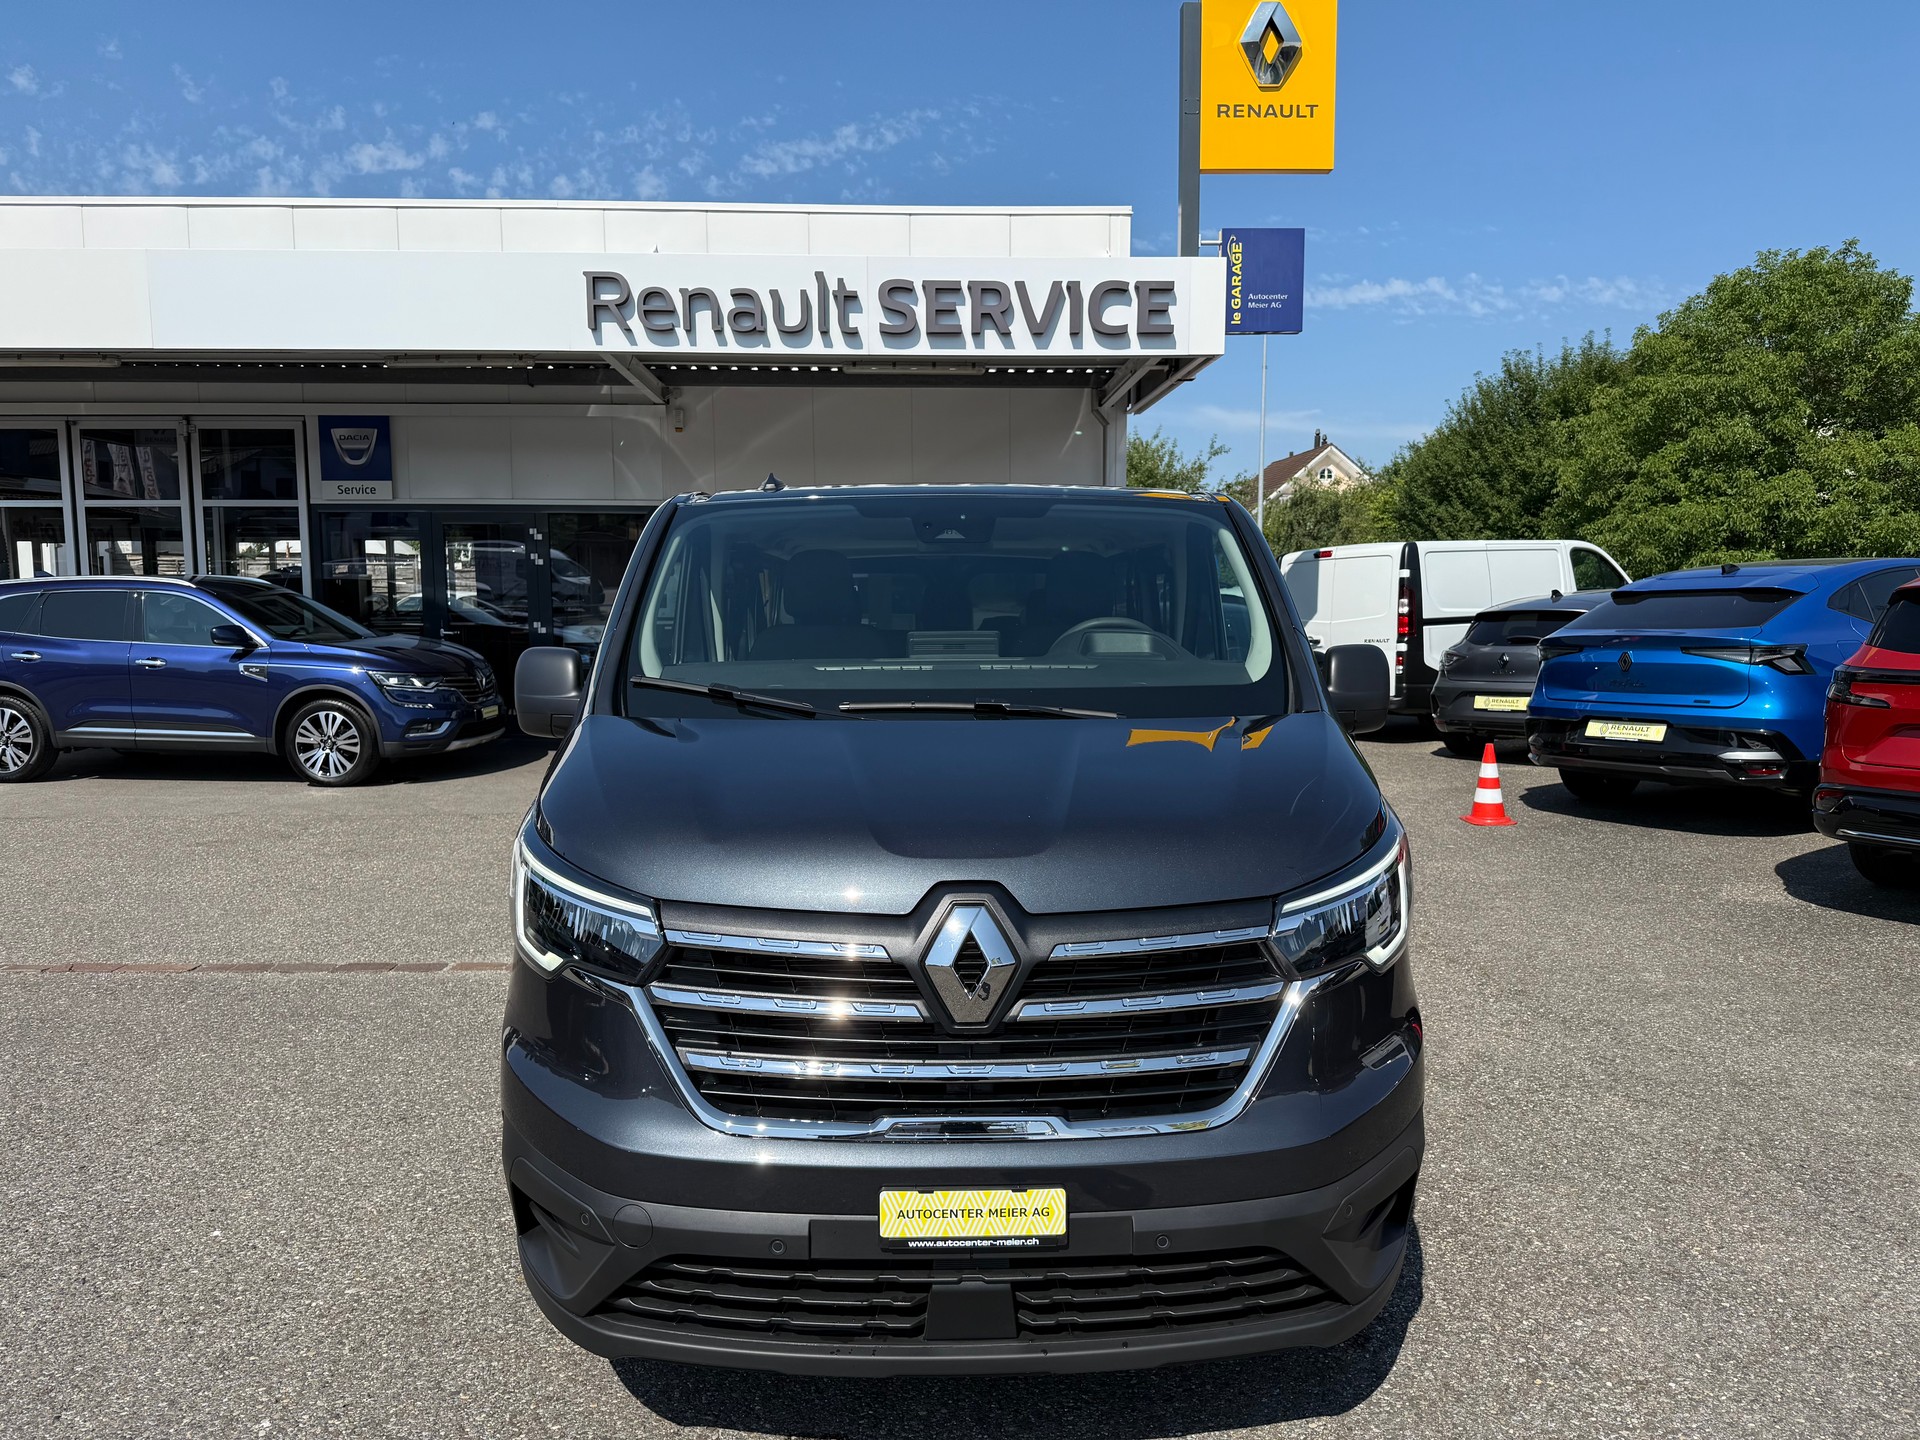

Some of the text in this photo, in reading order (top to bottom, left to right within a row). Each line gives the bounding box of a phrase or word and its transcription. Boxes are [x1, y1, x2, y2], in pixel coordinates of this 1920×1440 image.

[1217, 104, 1319, 118] RENAULT
[1231, 242, 1242, 325] le GARAGE
[583, 271, 1175, 335] Renault SERVICE
[337, 484, 377, 495] Service
[897, 1206, 1050, 1219] AUTOCENTER MEIER AG
[908, 1237, 1039, 1248] www.autocenter-meier.ch
